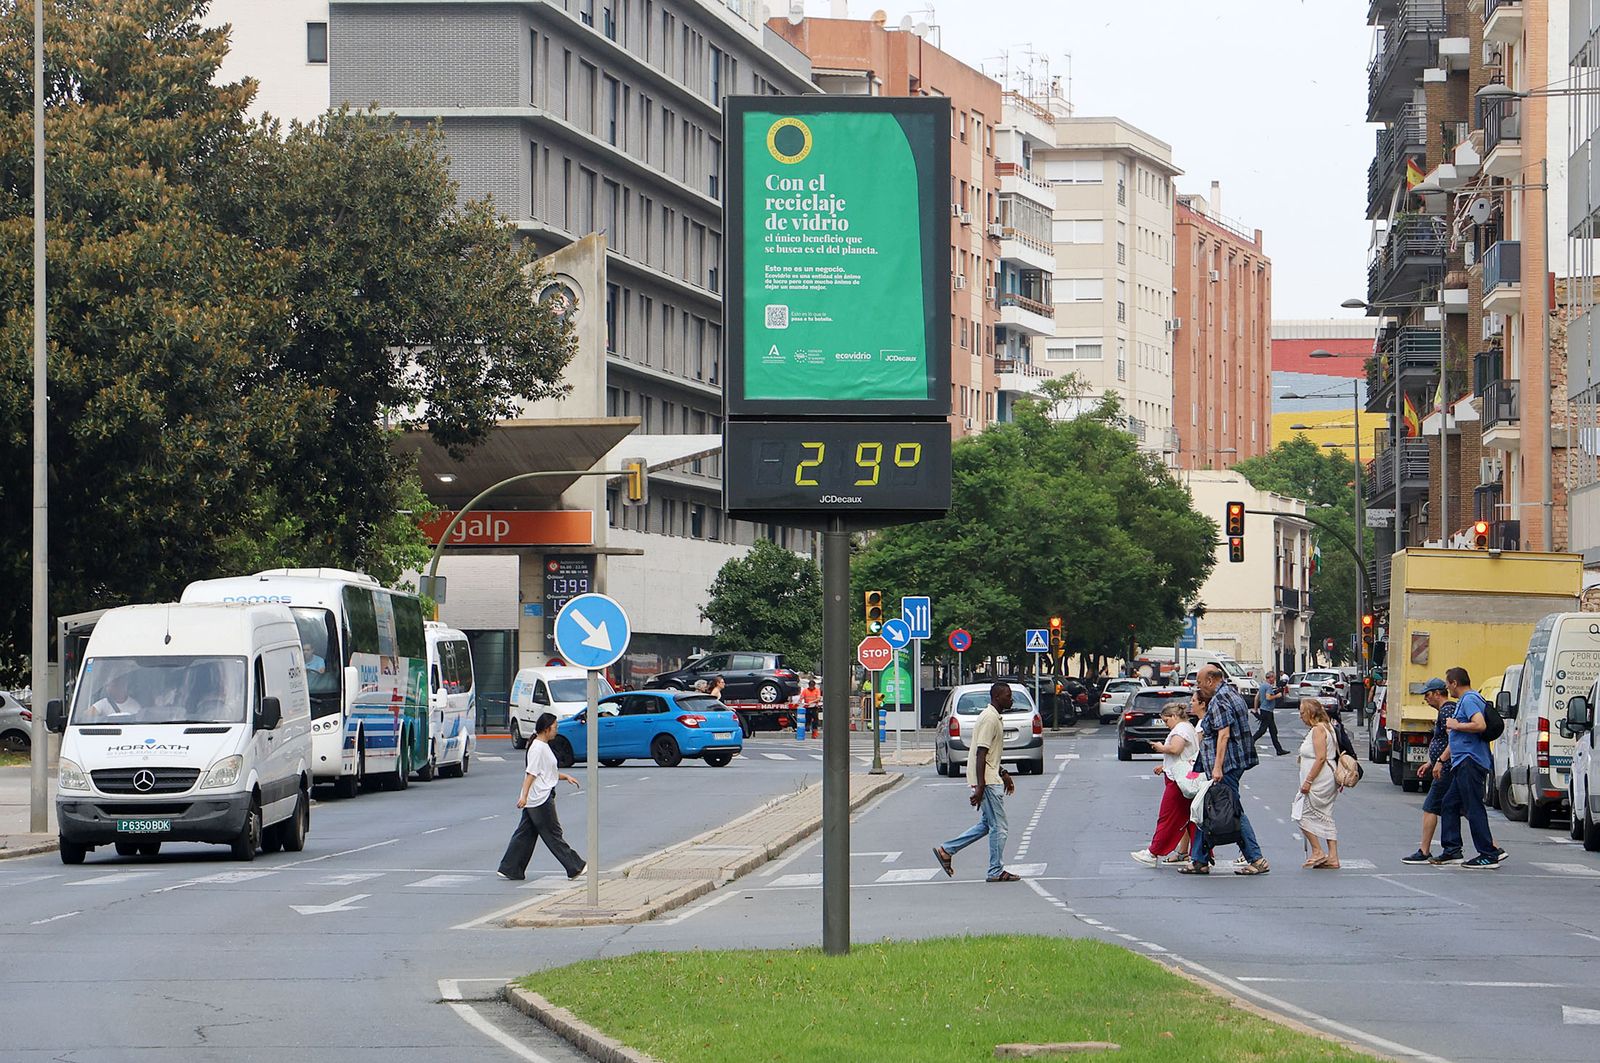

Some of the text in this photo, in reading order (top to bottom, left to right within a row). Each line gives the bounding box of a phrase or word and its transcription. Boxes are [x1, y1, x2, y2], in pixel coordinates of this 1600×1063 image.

[765, 174, 826, 191] Con el
[765, 193, 846, 215] reciclaje
[765, 212, 849, 231] de vidrio
[764, 233, 863, 245] el único beneficio que
[764, 245, 879, 256] se busca es el del planeta.
[815, 266, 846, 274] negocio.
[835, 352, 872, 360] ecovidrio
[819, 495, 862, 504] JCDecaux
[452, 514, 510, 542] galp
[862, 648, 889, 658] STOP
[108, 744, 190, 752] HORVATH
